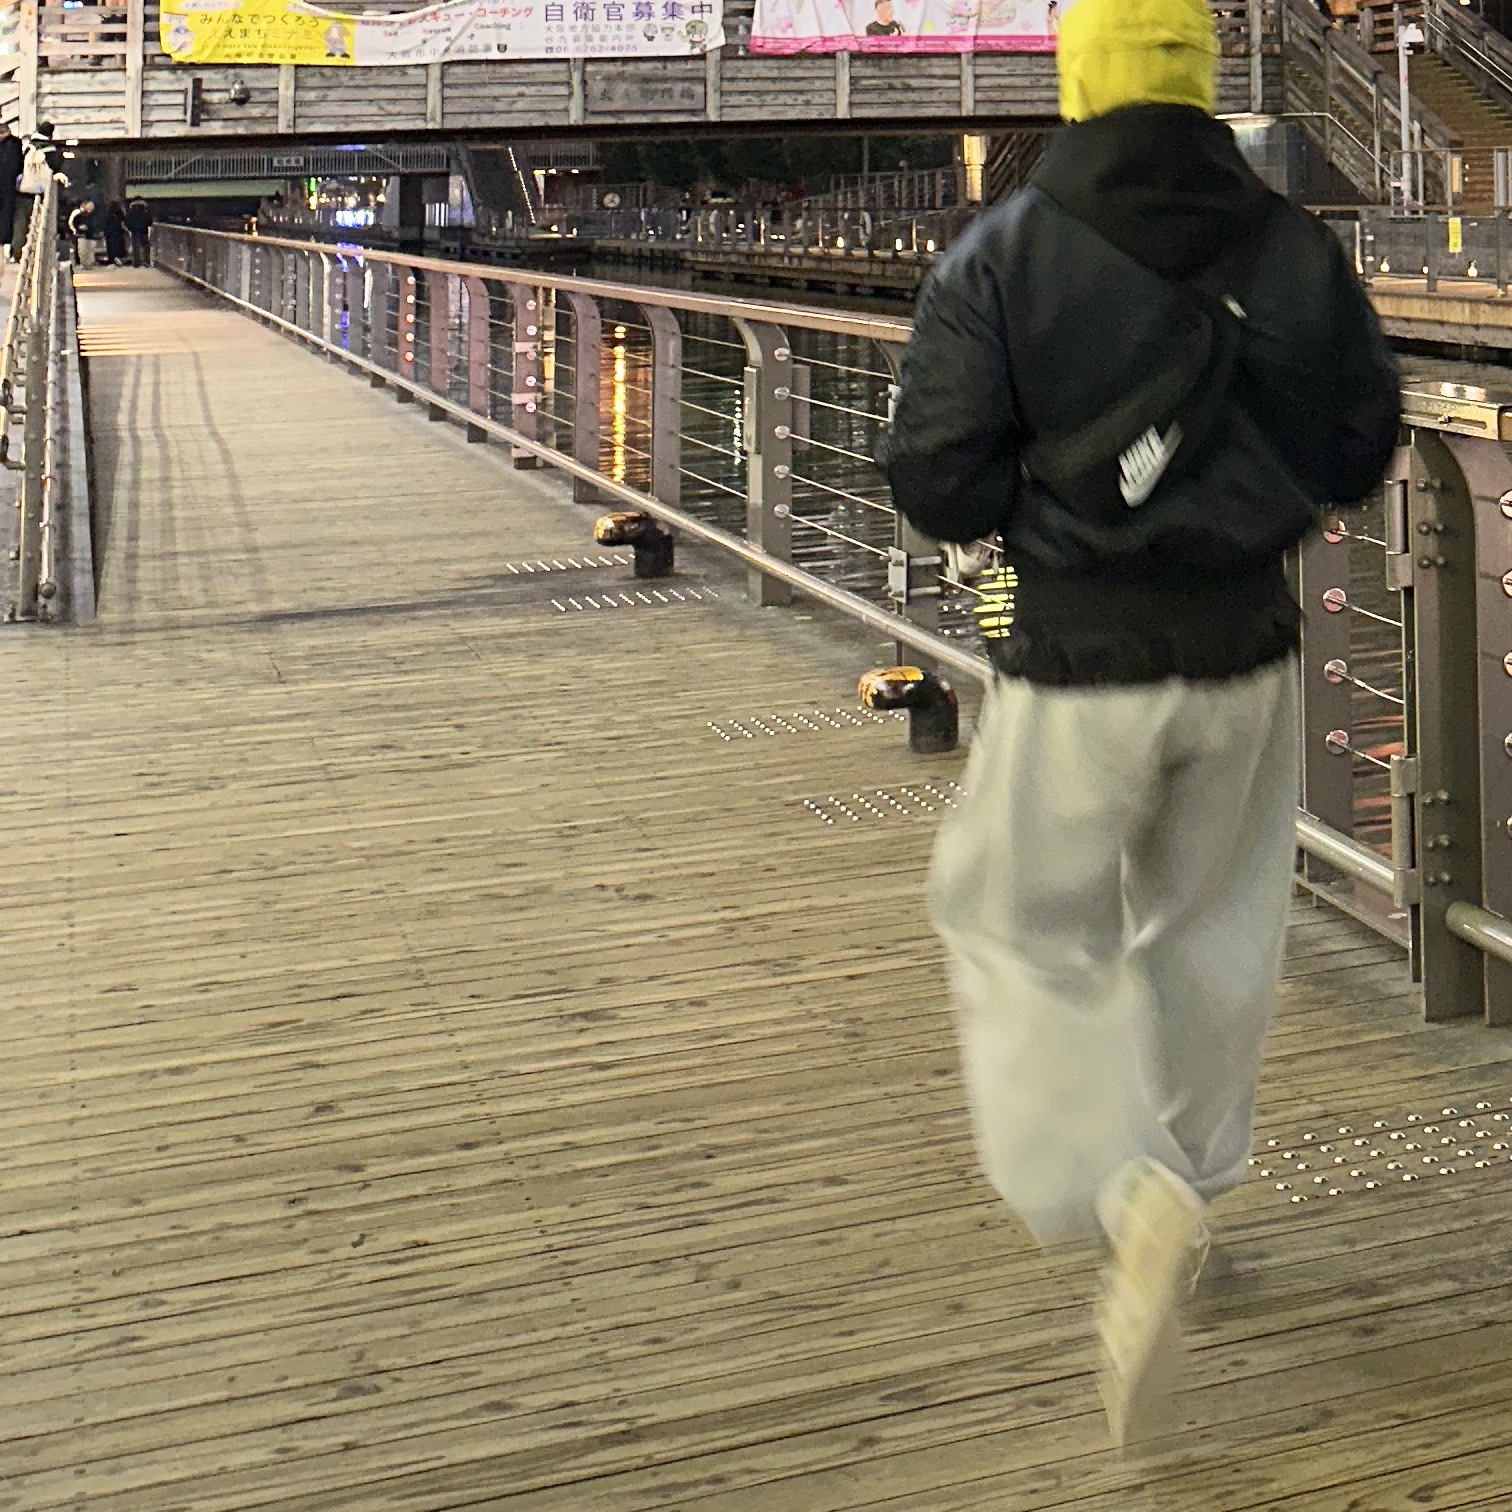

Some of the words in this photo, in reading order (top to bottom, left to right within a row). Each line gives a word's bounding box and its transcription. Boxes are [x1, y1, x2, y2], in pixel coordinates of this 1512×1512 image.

[199, 13, 320, 27] みんなでつくろう
[544, 0, 714, 22] 自衛官募集中
